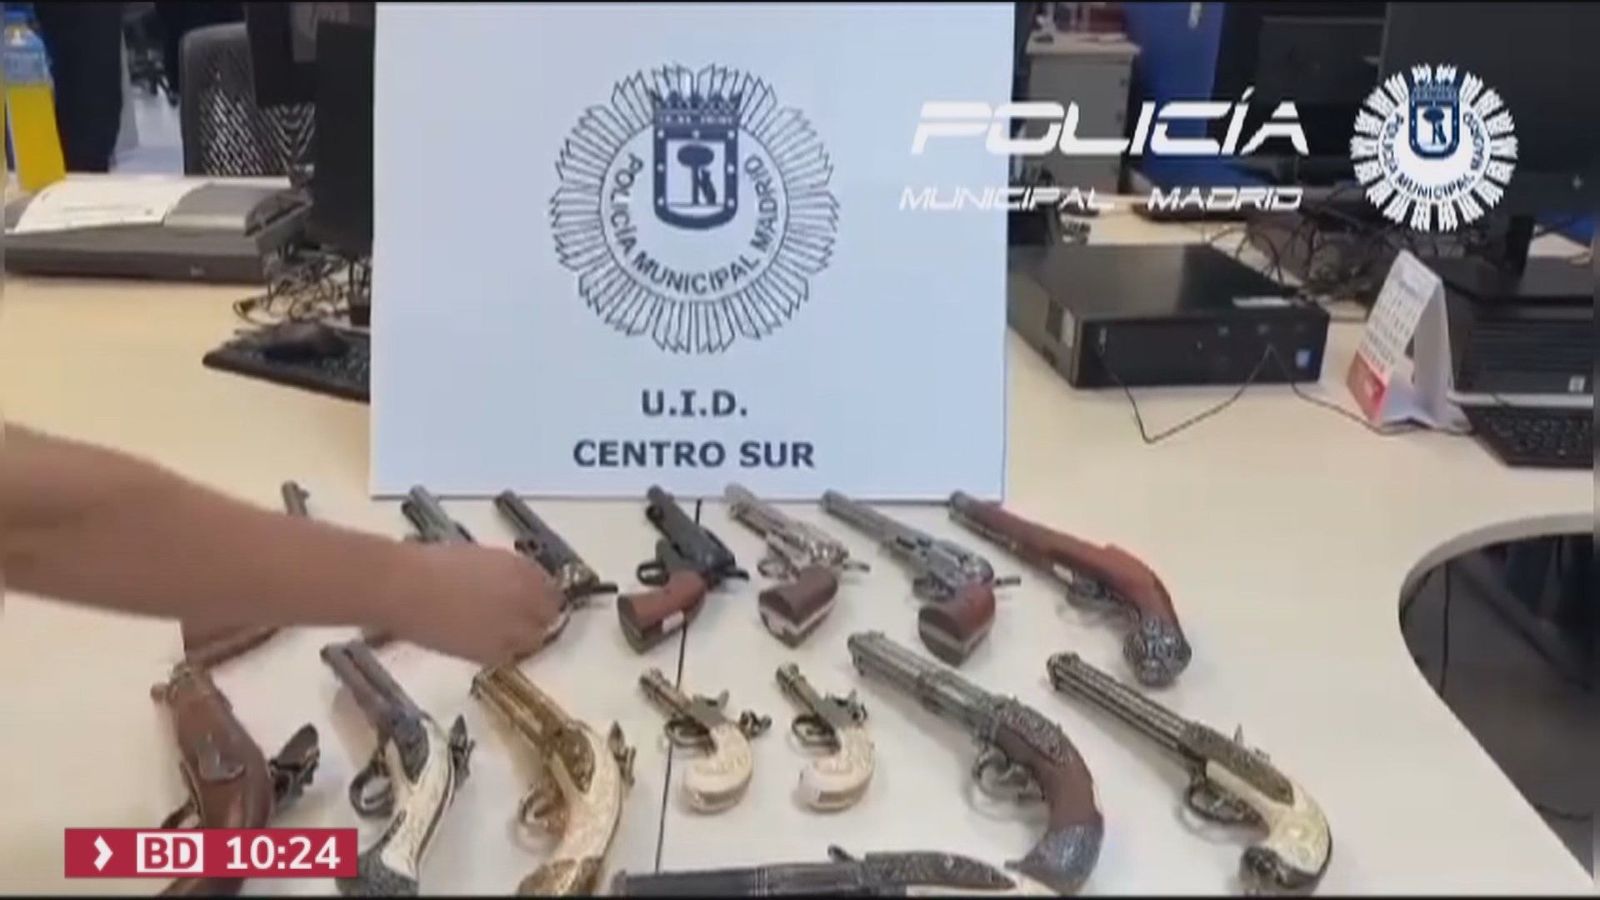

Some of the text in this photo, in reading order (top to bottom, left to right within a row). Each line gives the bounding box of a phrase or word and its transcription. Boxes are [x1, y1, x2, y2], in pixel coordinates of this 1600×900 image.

[611, 153, 778, 295] POLICÍA MUNICIPAL MADRID
[641, 389, 748, 417] U.I.D.
[573, 440, 815, 468] CENTRO SUR
